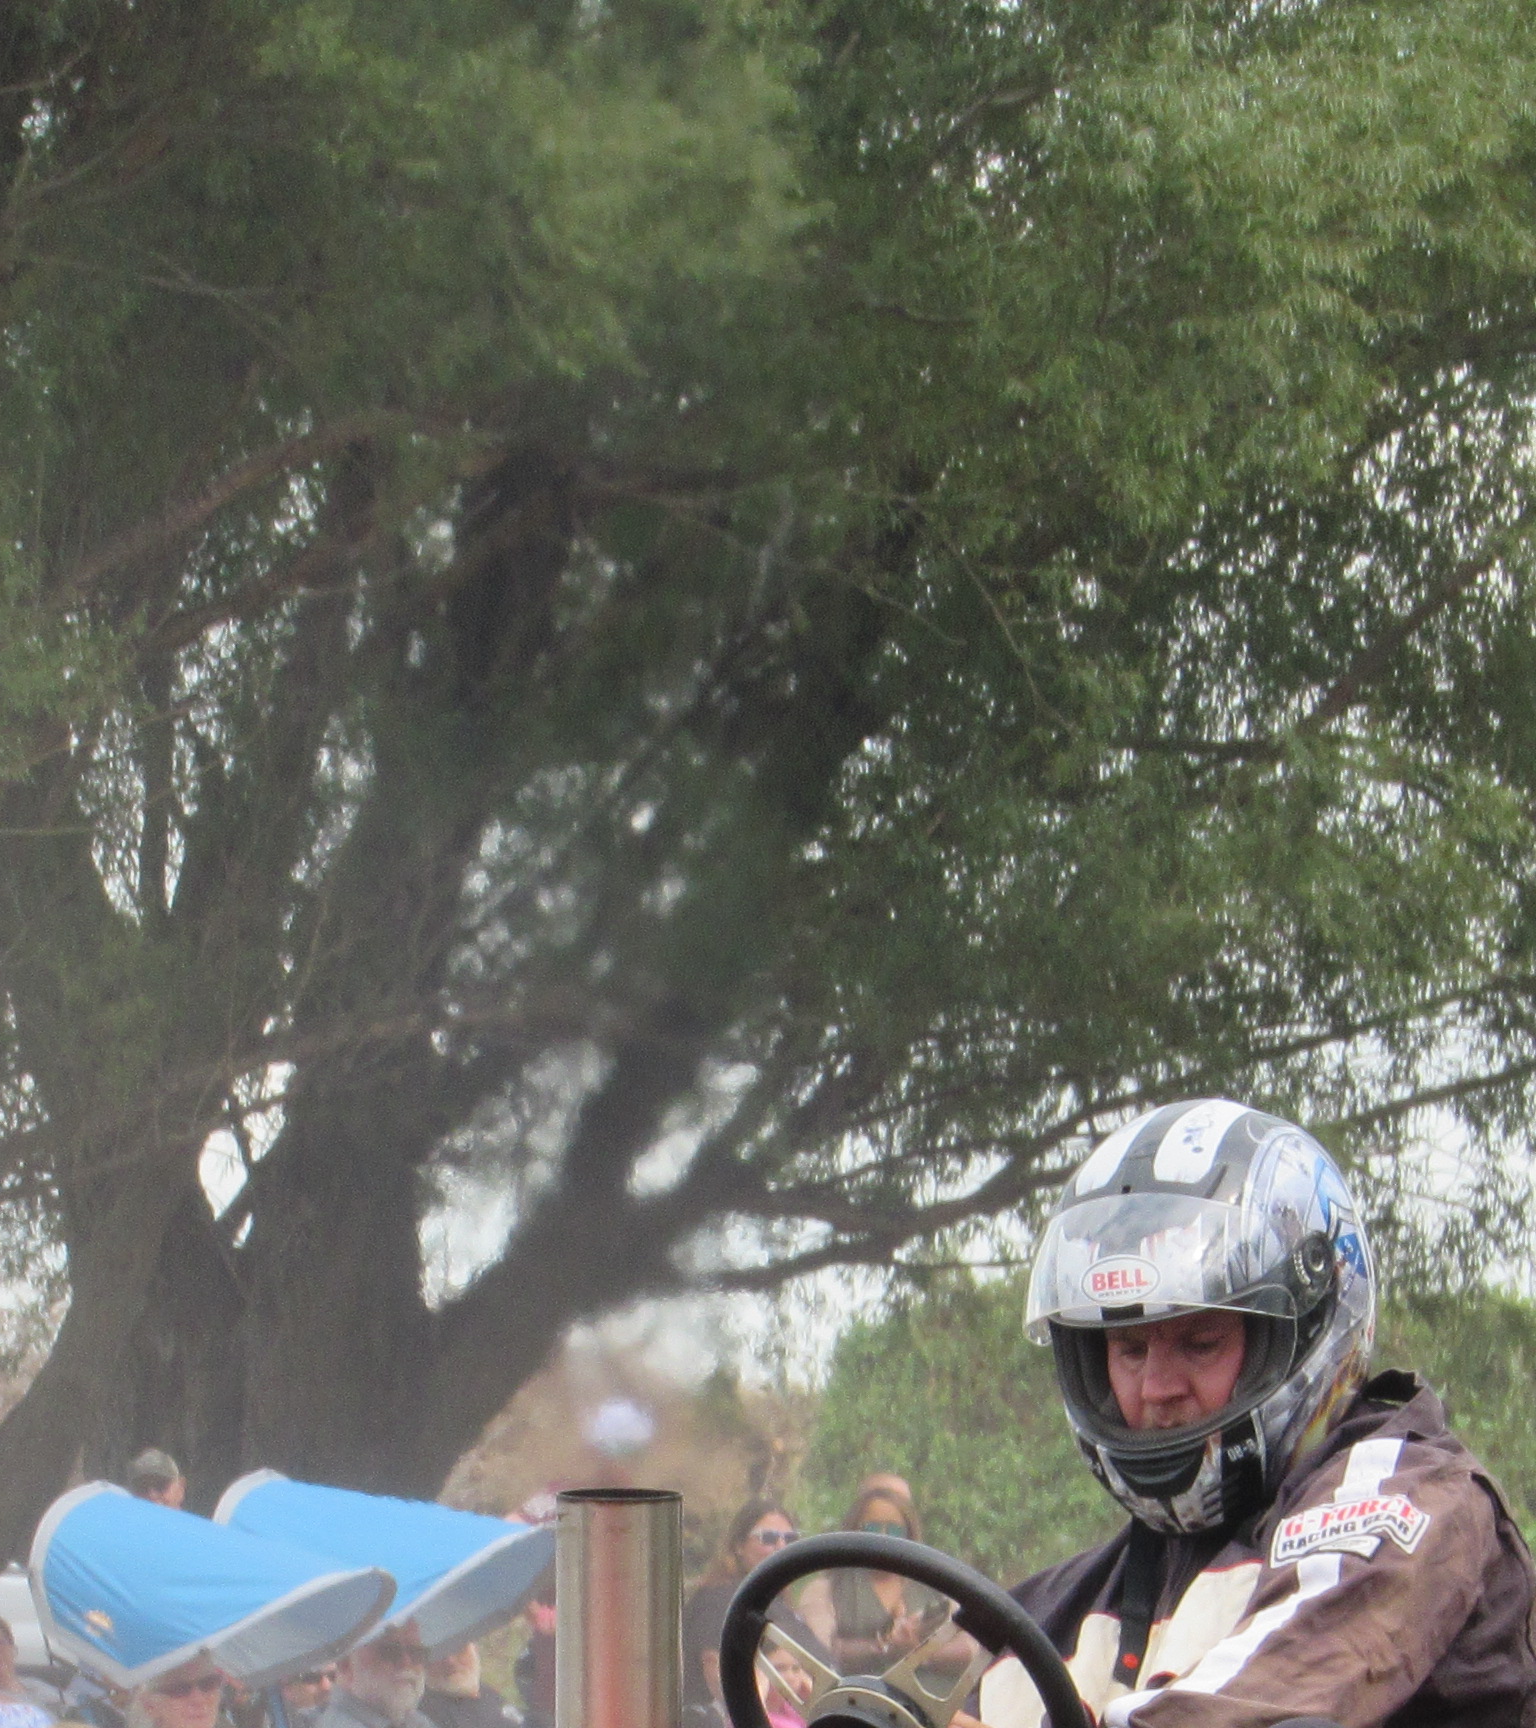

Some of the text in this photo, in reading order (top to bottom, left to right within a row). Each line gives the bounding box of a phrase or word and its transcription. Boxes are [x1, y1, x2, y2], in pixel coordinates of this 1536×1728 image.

[1092, 1268, 1149, 1292] BELL
[1282, 1520, 1357, 1552] RACING
[1362, 1513, 1410, 1536] GEAR
[1284, 1499, 1420, 1537] G-FORCE
